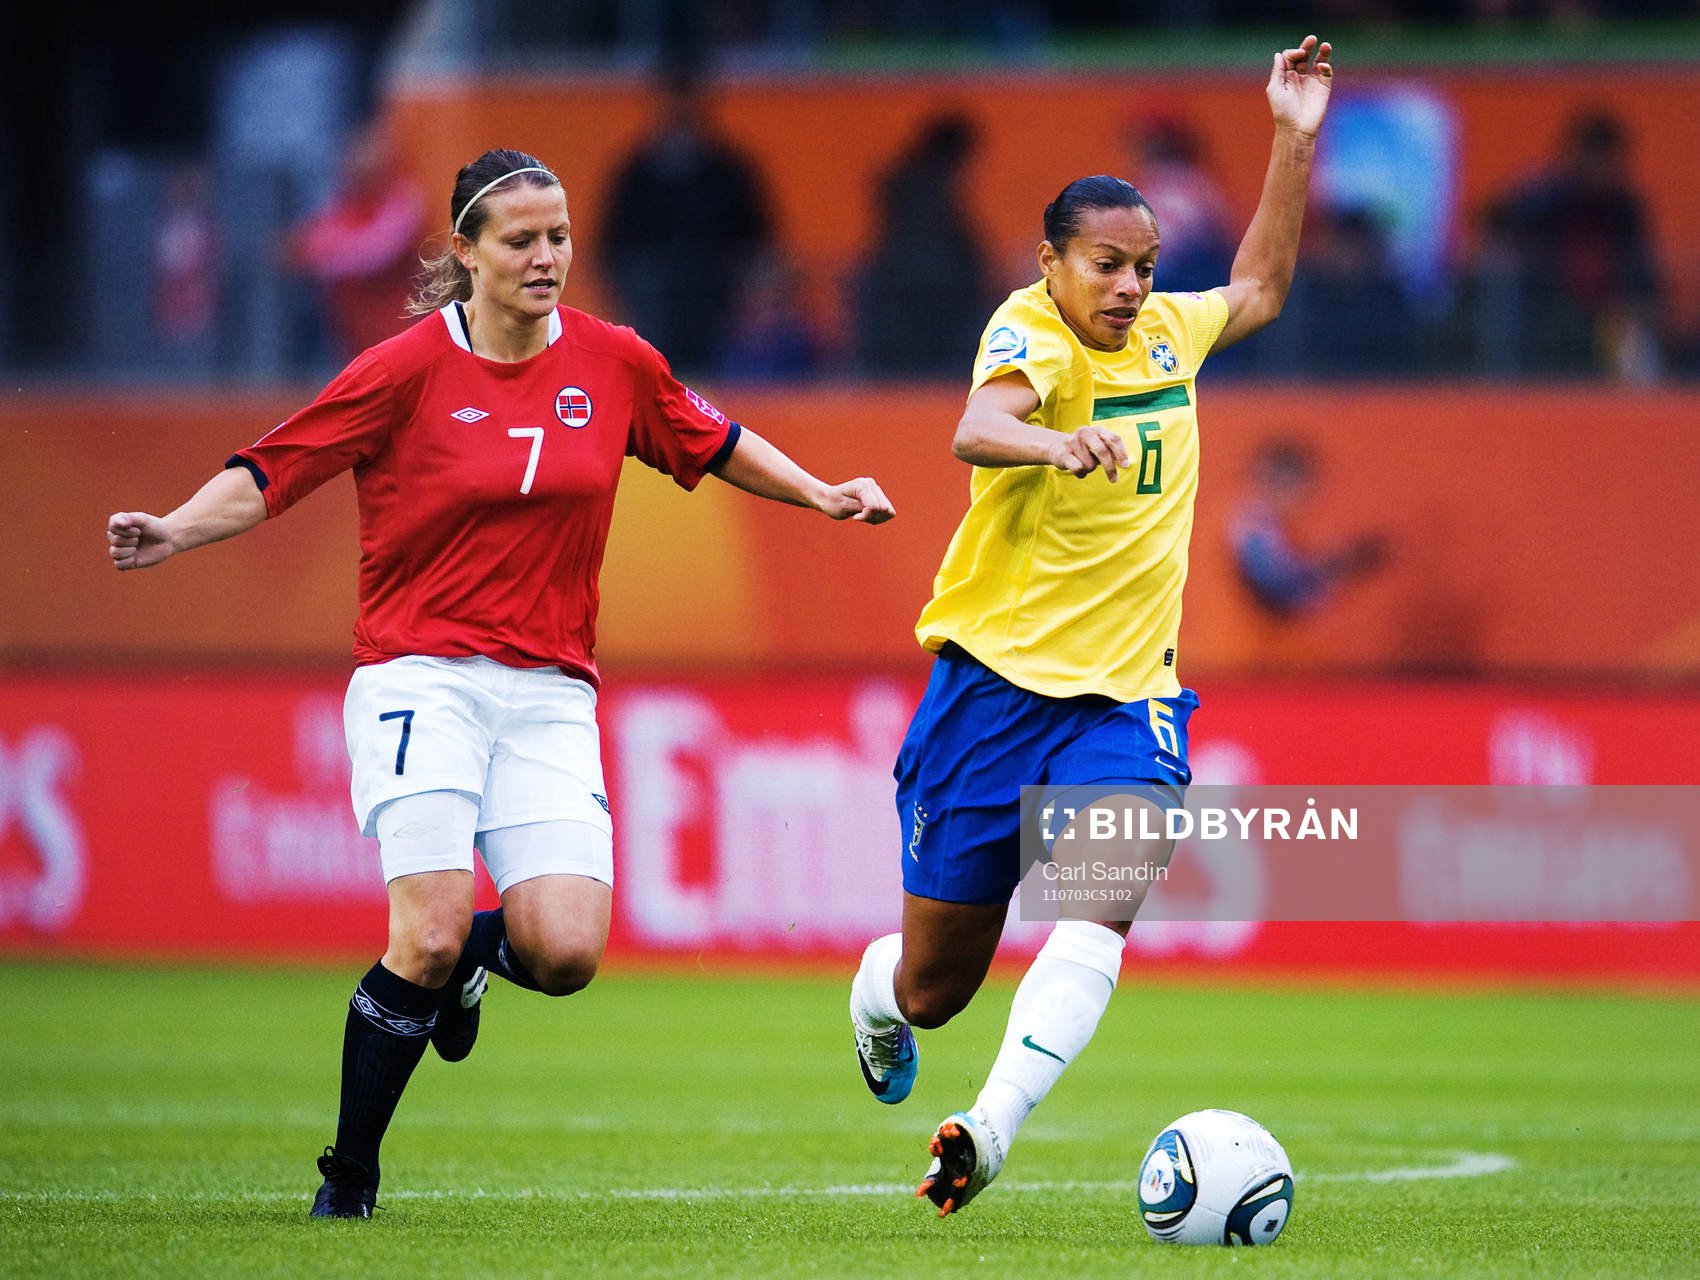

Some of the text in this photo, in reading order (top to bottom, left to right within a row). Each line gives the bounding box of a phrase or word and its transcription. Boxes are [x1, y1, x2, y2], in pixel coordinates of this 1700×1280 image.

[507, 427, 545, 495] 7
[1136, 421, 1162, 495] 6
[379, 709, 415, 776] 7
[1148, 697, 1179, 759] 6
